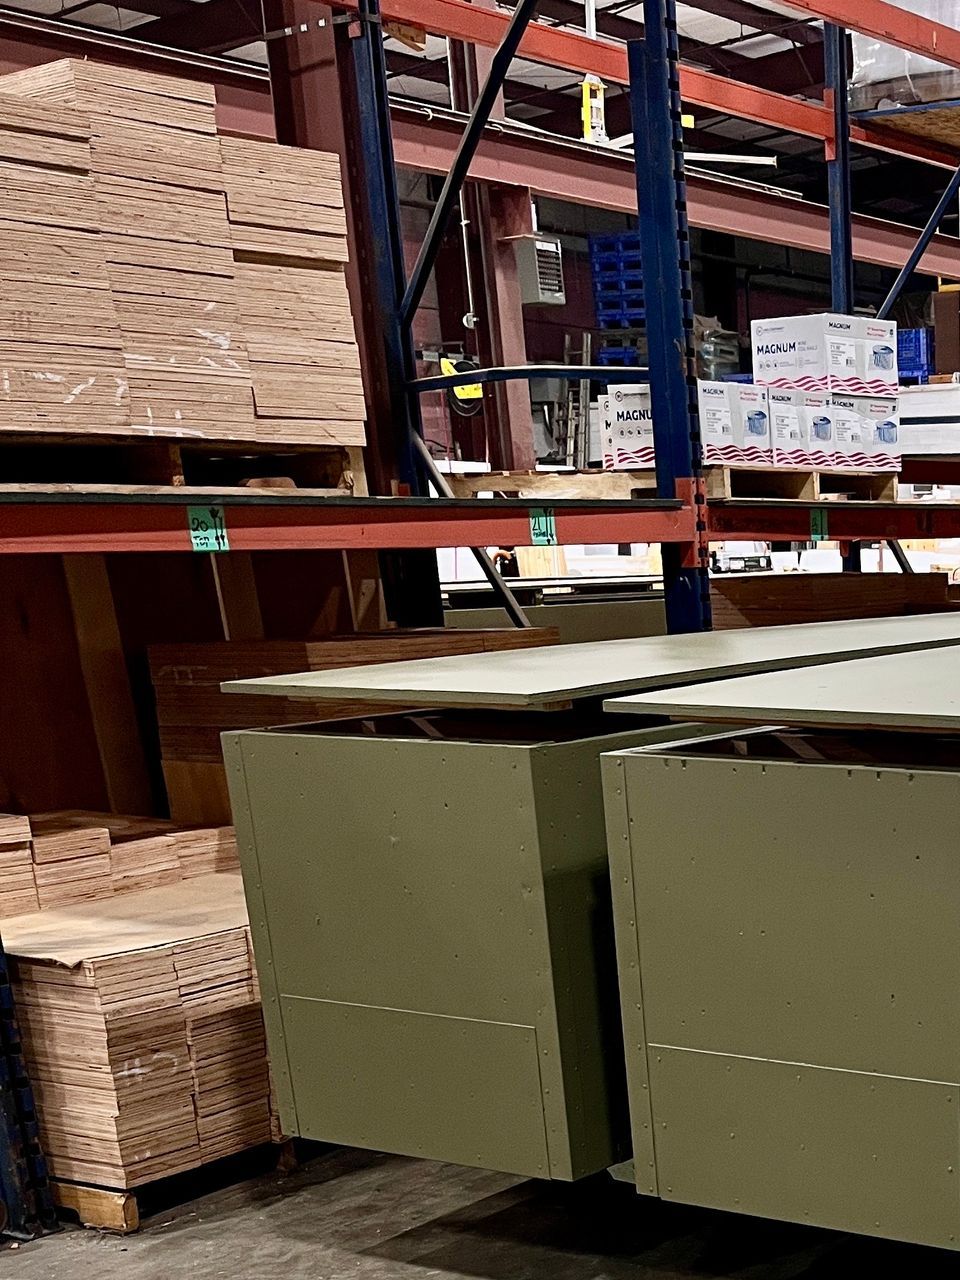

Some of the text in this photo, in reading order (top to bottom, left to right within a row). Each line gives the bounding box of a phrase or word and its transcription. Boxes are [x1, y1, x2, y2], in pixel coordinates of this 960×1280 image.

[829, 322, 850, 330] MAGNUM
[757, 342, 796, 355] MAGNUM
[617, 410, 652, 421] MAGNU
